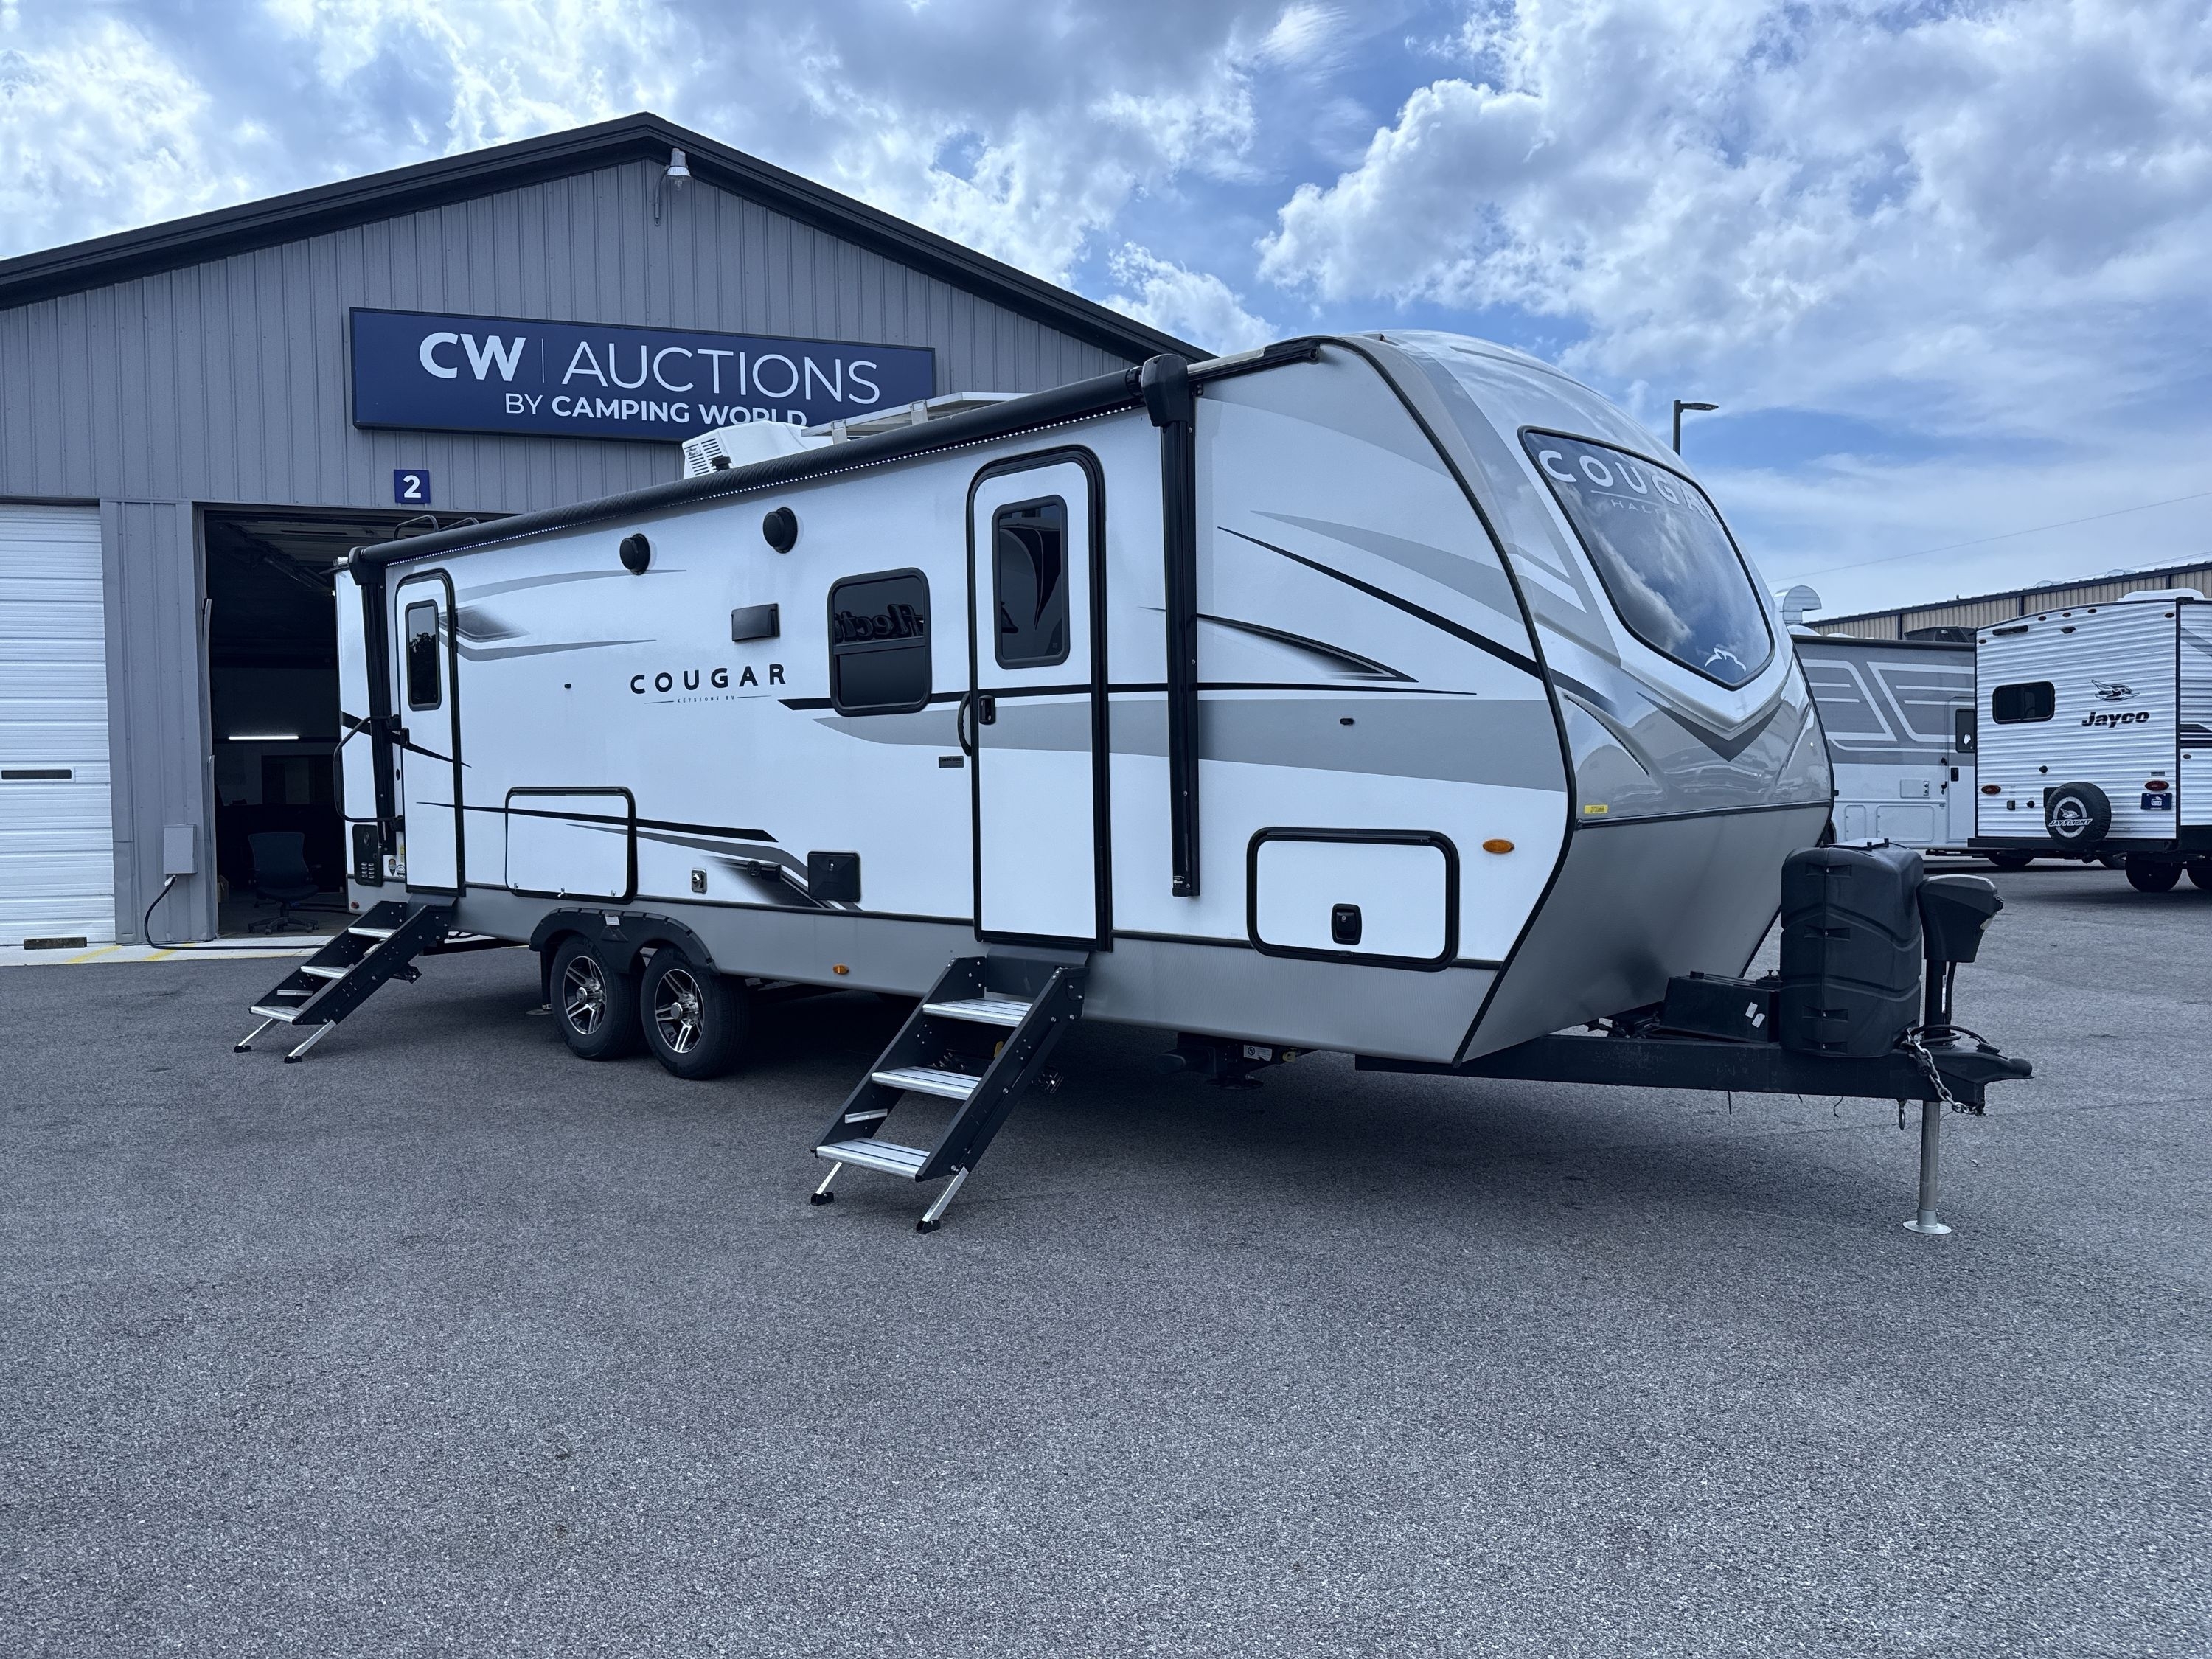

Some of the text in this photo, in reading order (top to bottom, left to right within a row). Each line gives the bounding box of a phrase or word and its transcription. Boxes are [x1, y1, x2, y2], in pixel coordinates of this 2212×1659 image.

[419, 331, 880, 404] CW AUCTIONS
[505, 392, 543, 415] BY
[552, 395, 690, 423] CAMPING
[403, 474, 422, 498] 2
[1538, 450, 1724, 529] COUGAR
[630, 663, 786, 695] COUGAR
[677, 695, 720, 703] KEYSTONE
[2081, 711, 2150, 728] Jayco
